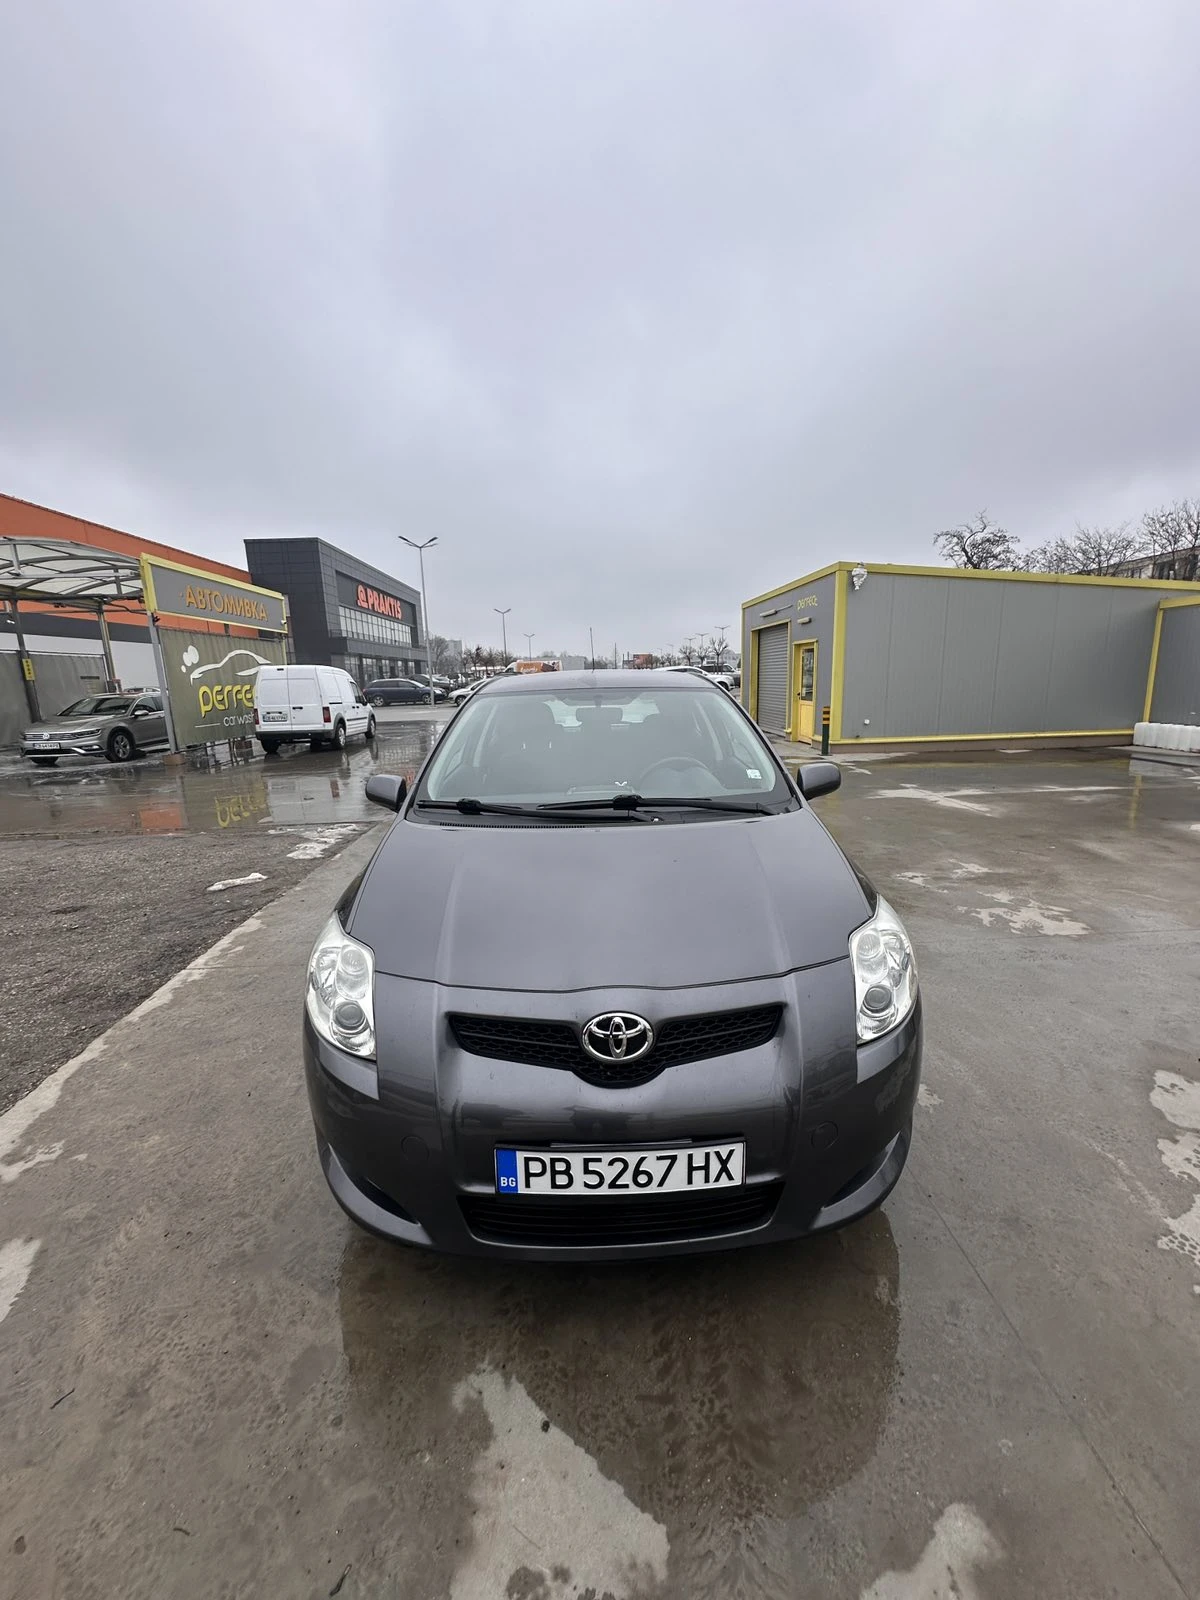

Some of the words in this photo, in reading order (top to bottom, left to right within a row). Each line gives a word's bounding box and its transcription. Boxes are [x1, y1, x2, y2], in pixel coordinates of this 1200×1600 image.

[185, 585, 268, 621] АВТОМИВКА
[366, 587, 402, 620] PRAKTIS
[198, 684, 256, 719] perfe
[223, 716, 237, 727] car
[500, 1176, 517, 1188] BG
[523, 1155, 574, 1190] PB
[582, 1154, 679, 1190] 5267
[686, 1148, 736, 1186] HX
